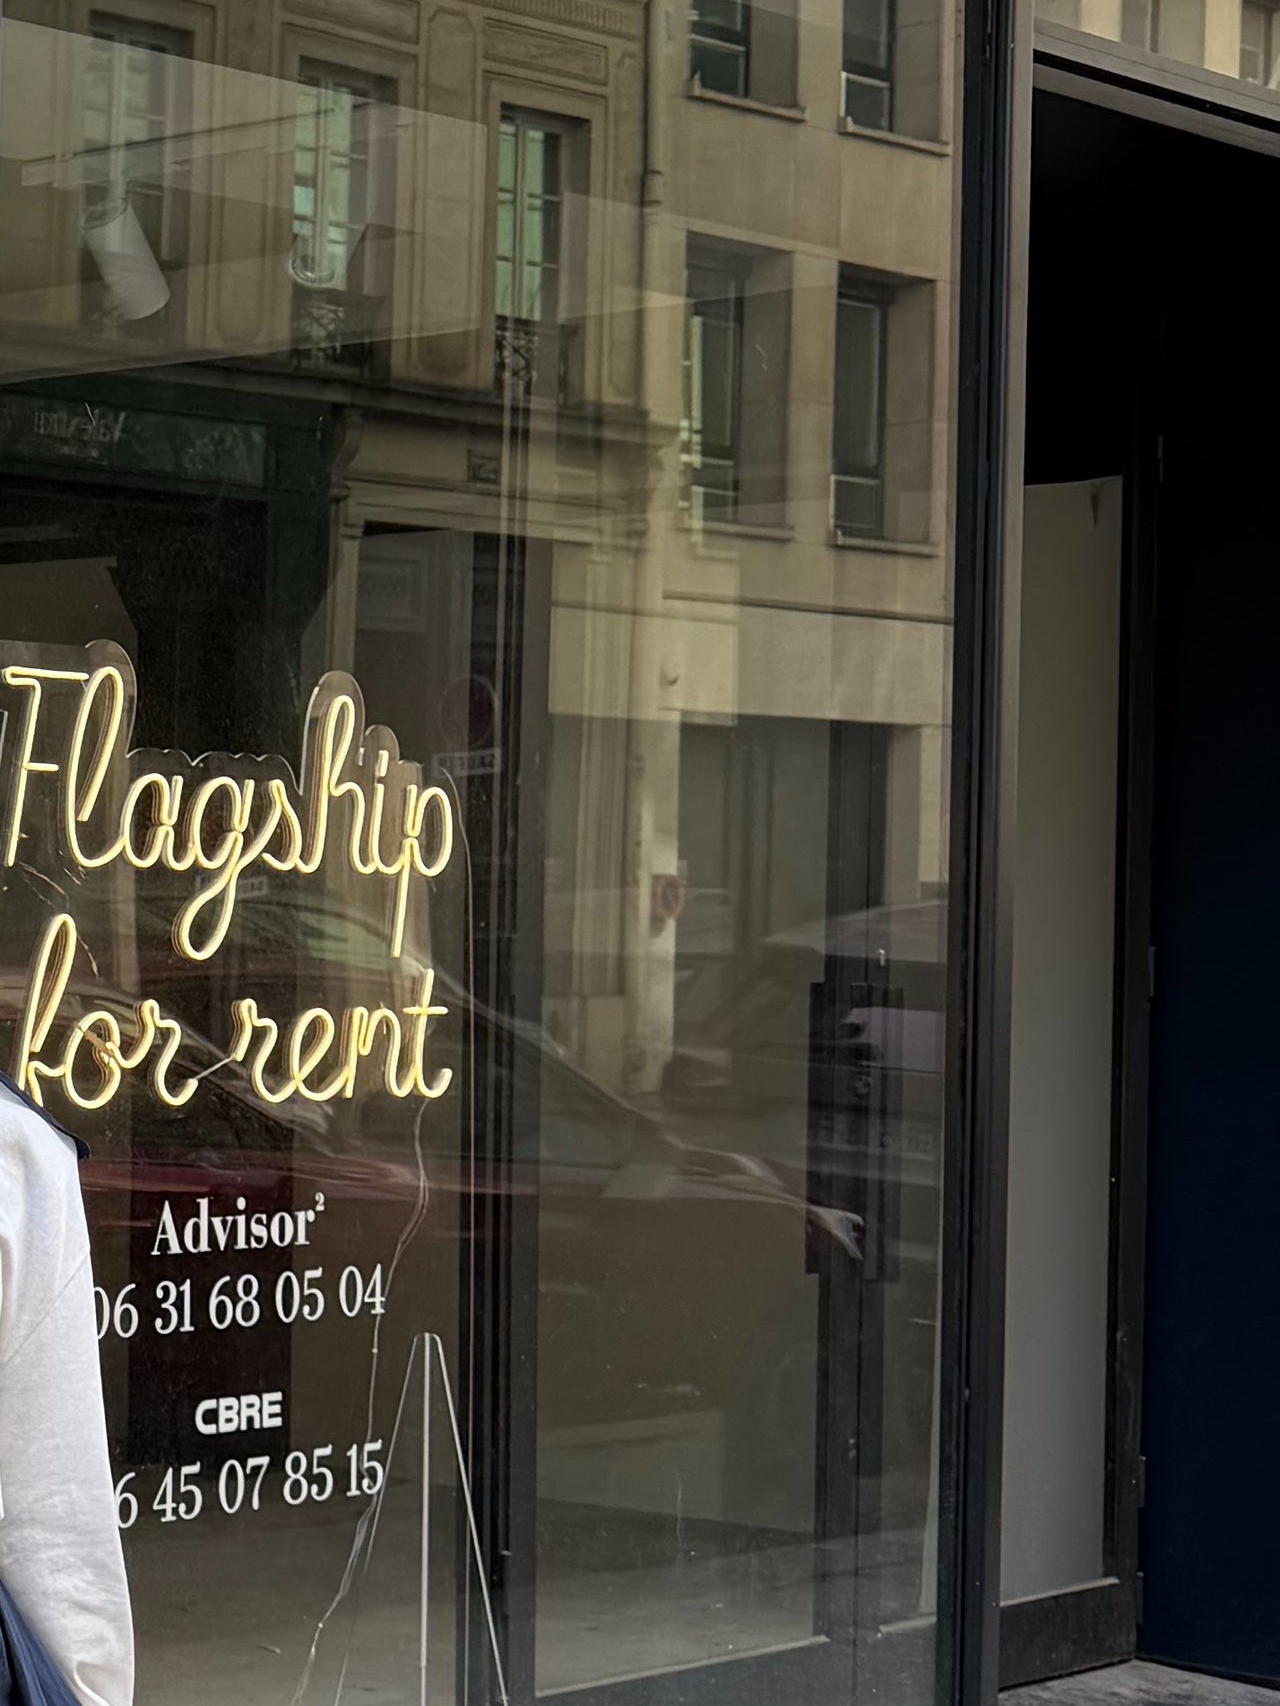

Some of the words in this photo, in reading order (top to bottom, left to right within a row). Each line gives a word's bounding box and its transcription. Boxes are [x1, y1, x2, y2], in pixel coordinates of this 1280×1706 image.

[4, 666, 452, 960] Flagship
[17, 914, 198, 1109] for
[233, 968, 452, 1103] rent
[155, 1278, 195, 1334] 31
[208, 1274, 260, 1329] 68
[275, 1267, 324, 1323] 05
[339, 1263, 386, 1317] 04
[195, 1392, 282, 1435] CBRE
[114, 1472, 138, 1528] 6
[152, 1462, 203, 1523] 45
[218, 1456, 271, 1515] 07
[283, 1444, 334, 1505] 85
[346, 1439, 384, 1497] 15
